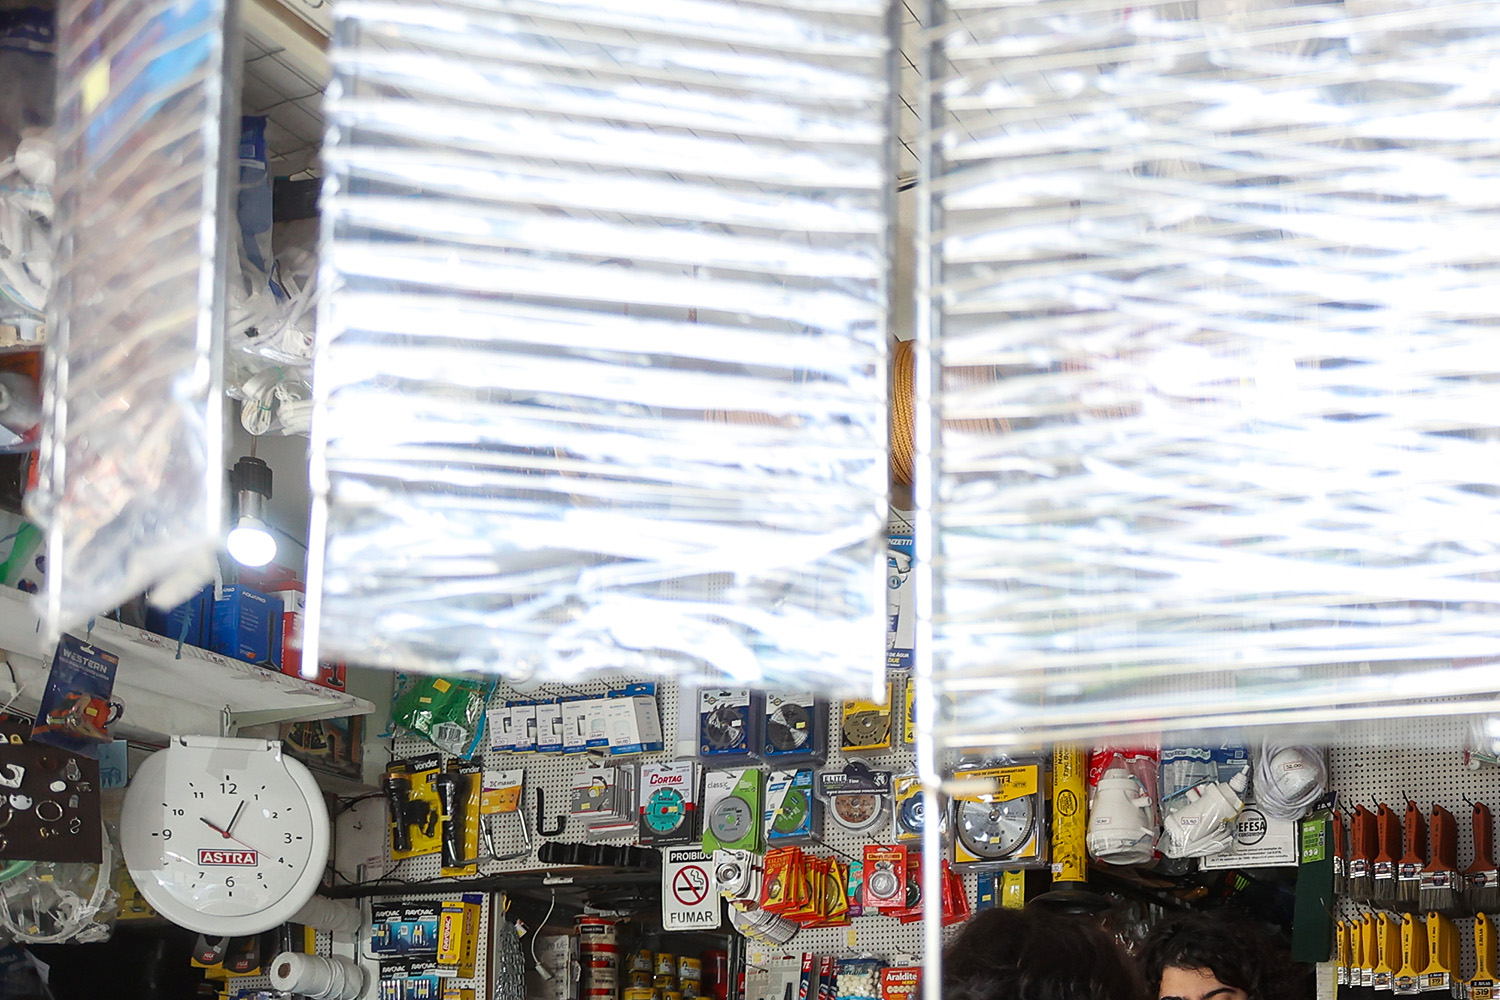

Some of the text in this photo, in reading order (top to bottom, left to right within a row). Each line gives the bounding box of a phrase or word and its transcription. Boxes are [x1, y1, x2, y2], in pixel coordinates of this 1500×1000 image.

[62, 648, 107, 674] WESTERN
[414, 759, 438, 771] vonder
[459, 766, 480, 775] vonder
[822, 774, 847, 783] ELITE
[220, 782, 237, 795] 12
[707, 780, 728, 790] classic
[193, 791, 204, 799] 11
[1237, 821, 1267, 832] EFESA
[162, 829, 172, 841] 9
[284, 832, 292, 843] 3
[202, 851, 255, 864] ASTRA
[225, 876, 235, 887] 6
[405, 908, 434, 916] RAYOVAC
[670, 910, 713, 924] FUMAR
[443, 915, 452, 952] RAYOVAC
[382, 965, 406, 973] RAYOVAC
[411, 961, 437, 970] RAYOVAC
[886, 972, 918, 981] Araldite
[1475, 988, 1490, 996] 319
